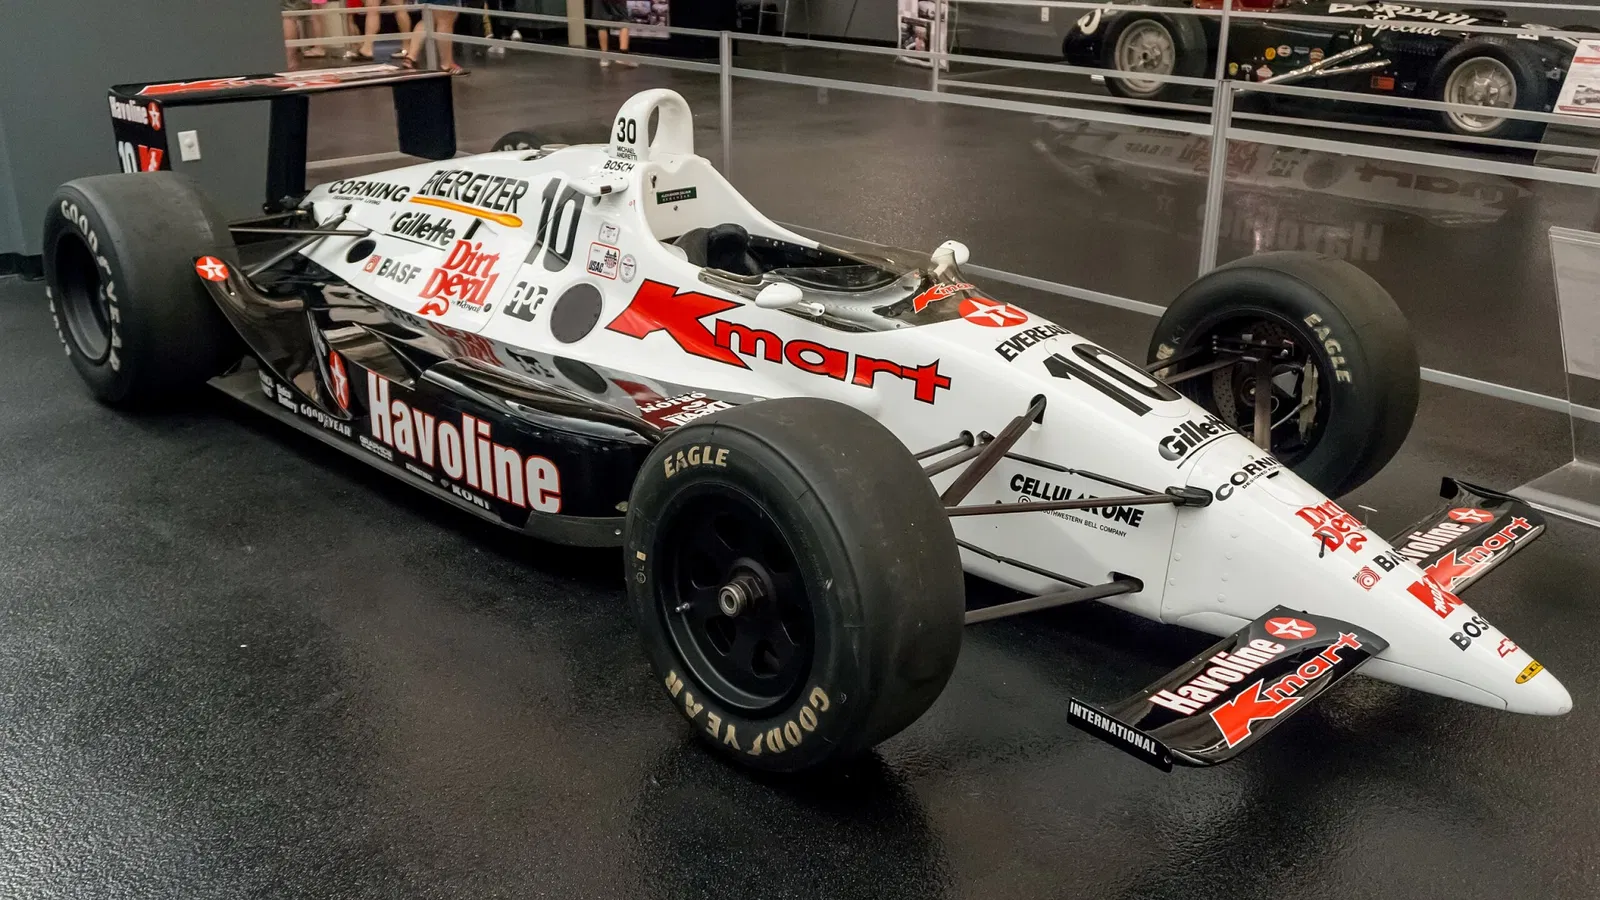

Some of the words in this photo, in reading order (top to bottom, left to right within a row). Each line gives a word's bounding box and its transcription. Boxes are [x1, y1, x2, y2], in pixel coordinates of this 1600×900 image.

[108, 95, 149, 125] Havoline
[617, 117, 636, 144] 30
[603, 160, 635, 173] BOSCH
[328, 180, 410, 202] CORNING
[418, 170, 529, 214] ENERGIZER
[391, 212, 455, 246] Gillette
[523, 177, 586, 273] 10
[377, 258, 422, 284] BASF
[441, 239, 500, 278] Dirt
[418, 267, 500, 306] Devil
[604, 278, 952, 405] Kmart
[1303, 313, 1353, 385] EAGLE
[1042, 343, 1183, 417] 10
[300, 404, 351, 437] GOODYEAR
[367, 370, 562, 514] Havoline
[664, 446, 729, 479] EAGLE
[452, 484, 490, 510] KONI
[1101, 505, 1144, 528] ONE
[1041, 509, 1083, 525] OUTHWESTERN
[1084, 519, 1098, 529] BELL
[1099, 525, 1127, 538] COMPANY
[1423, 516, 1532, 592] Kmart
[1148, 638, 1286, 716] Havoline
[1209, 631, 1362, 749] Kmart
[665, 670, 831, 756] GOODYEAR
[1069, 701, 1157, 756] INTERNATIONAL
